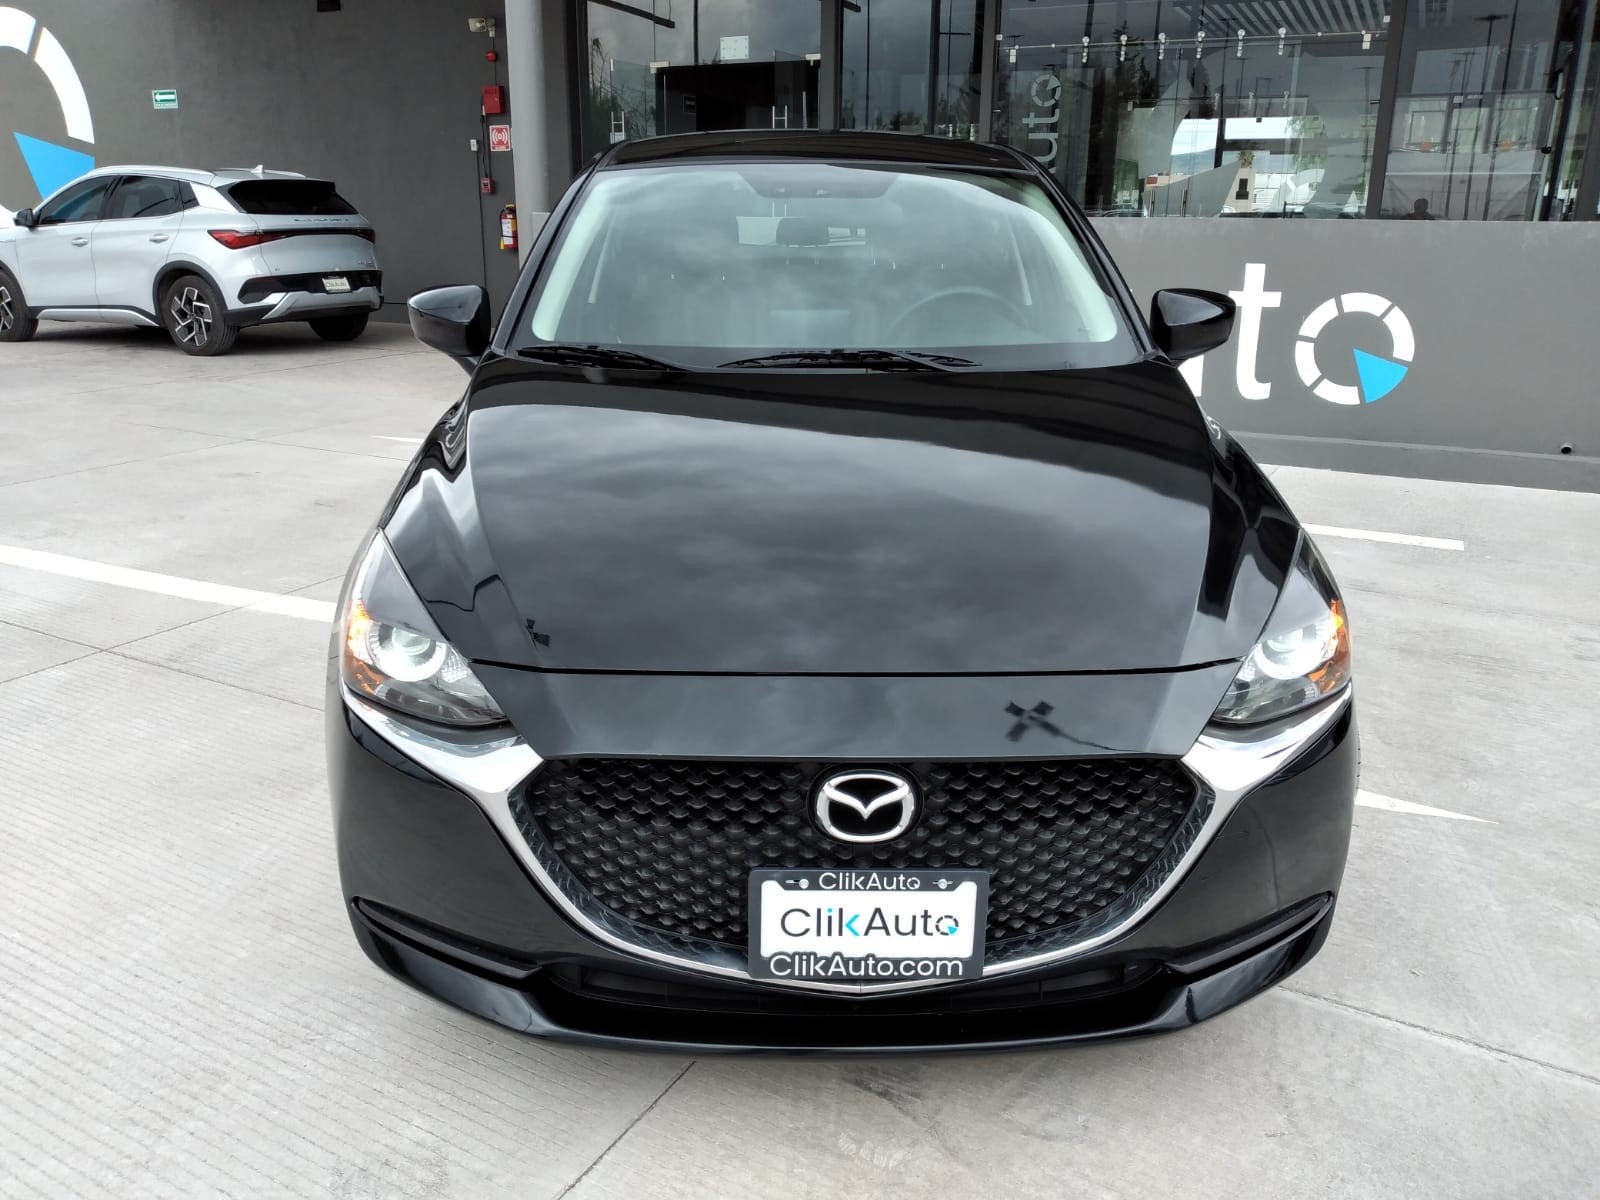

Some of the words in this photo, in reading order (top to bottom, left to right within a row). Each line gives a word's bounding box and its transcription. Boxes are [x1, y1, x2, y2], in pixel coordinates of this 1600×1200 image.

[1022, 74, 1062, 174] uto
[1178, 262, 1415, 405] to
[818, 872, 921, 890] ClikAuto
[780, 907, 960, 937] ClikAuto
[769, 954, 964, 977] ClikAuto.com
